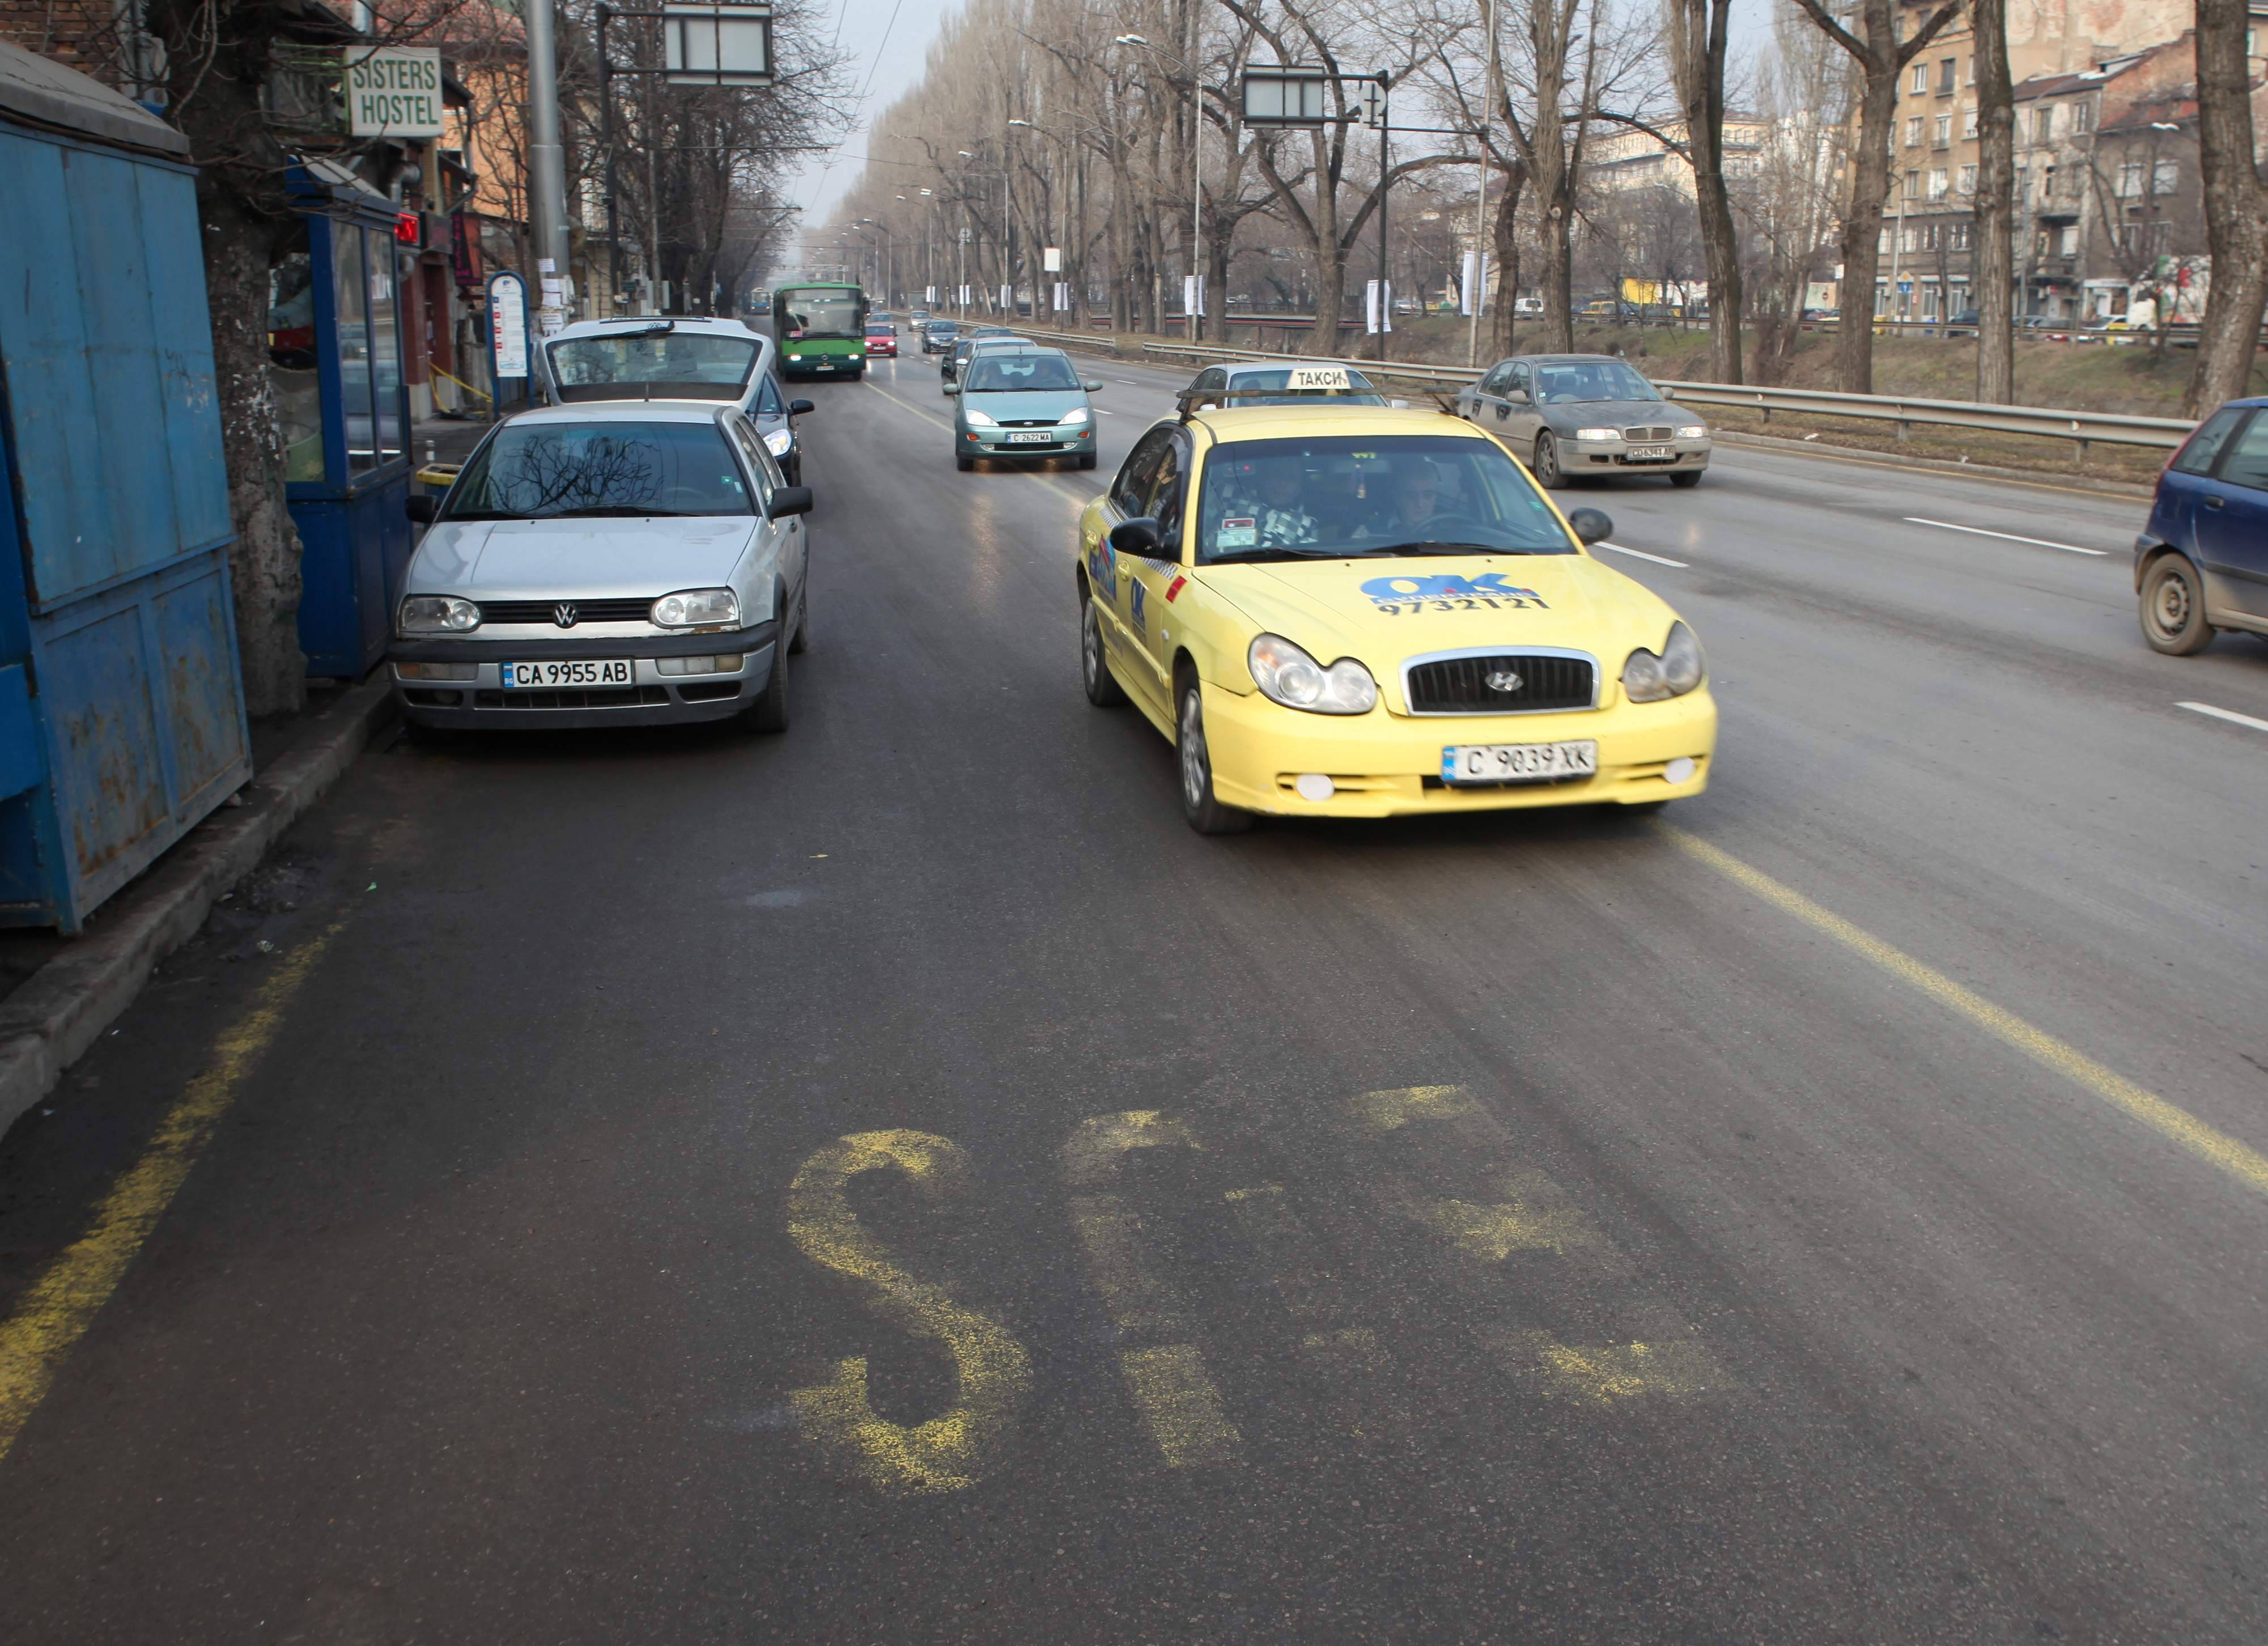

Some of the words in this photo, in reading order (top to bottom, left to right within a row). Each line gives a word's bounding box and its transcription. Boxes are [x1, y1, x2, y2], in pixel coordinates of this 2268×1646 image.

[354, 59, 436, 90] SISTERS
[362, 95, 439, 125] HOSTEL
[1297, 372, 1342, 385] ТАКСИ
[1377, 597, 1551, 616] 9732121
[516, 665, 543, 685] CA
[547, 663, 597, 684] 9955
[602, 662, 627, 682] AB
[1468, 750, 1484, 774] C
